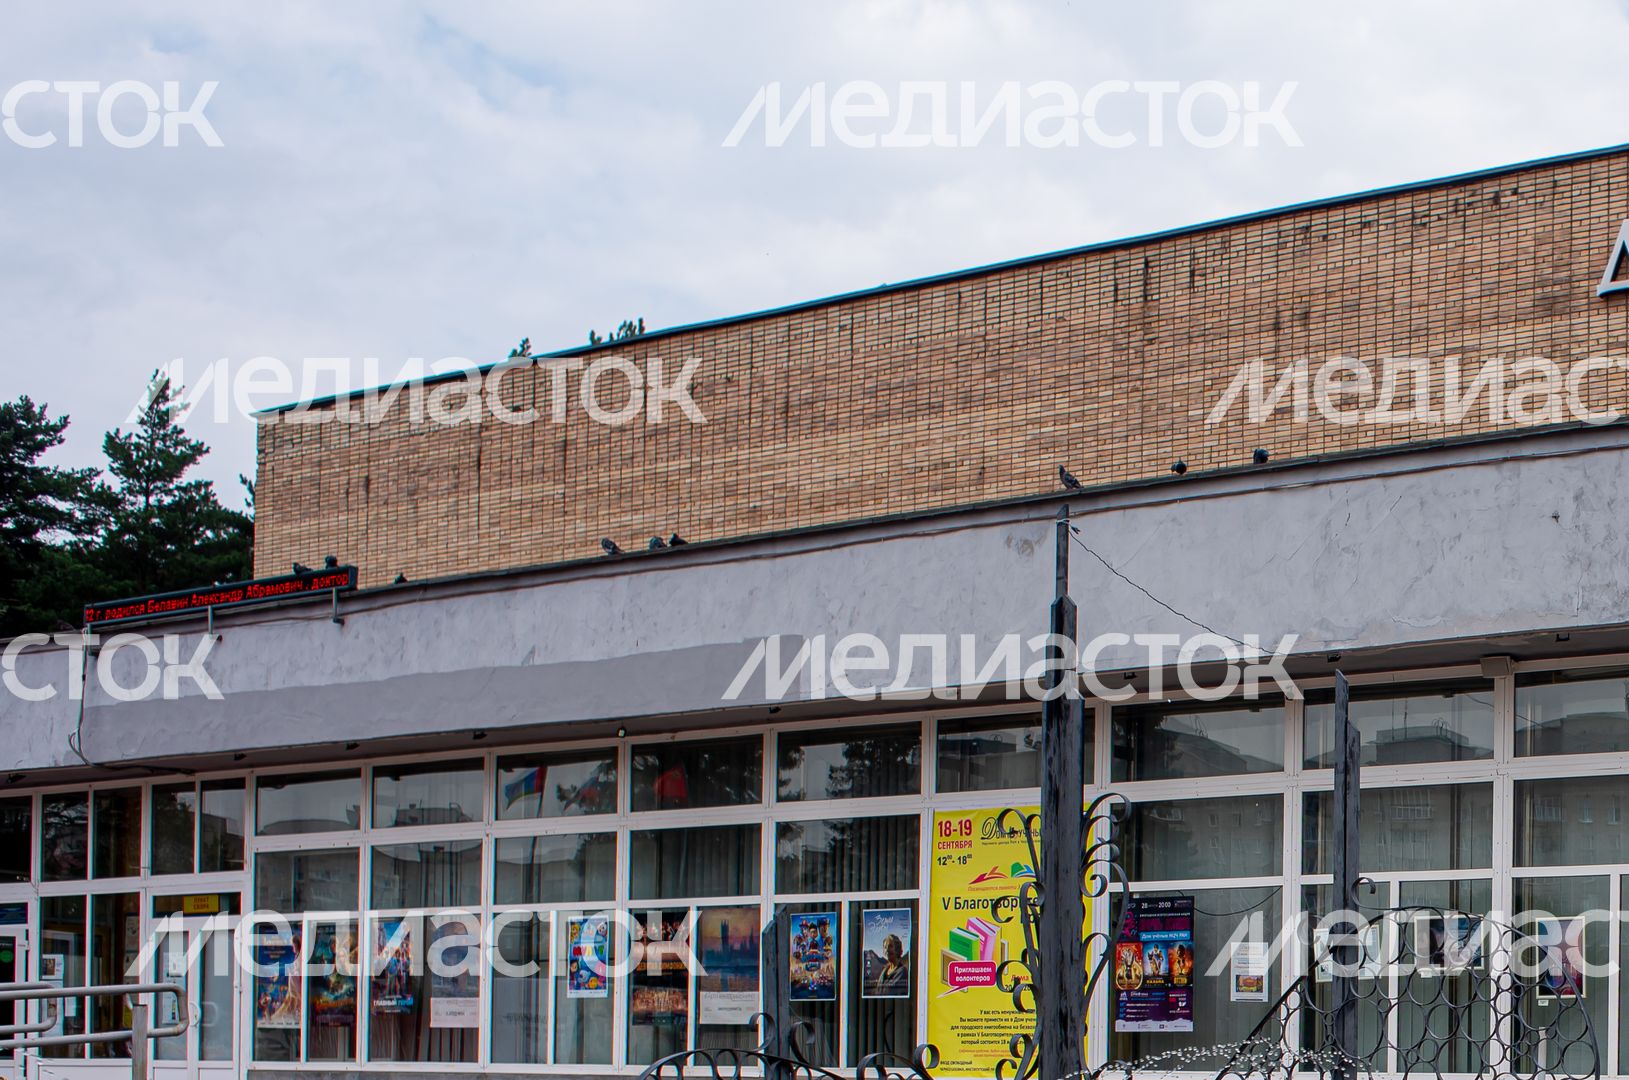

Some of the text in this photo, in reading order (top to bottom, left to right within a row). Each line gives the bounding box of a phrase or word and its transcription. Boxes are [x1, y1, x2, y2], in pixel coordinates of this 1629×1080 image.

[105, 604, 145, 620] родился
[147, 598, 189, 613] Белавин
[191, 590, 243, 607] Александр
[246, 581, 303, 599] Абрамович
[312, 574, 349, 591] доктор
[938, 818, 973, 838] 18-19
[938, 840, 973, 850] СЕНТЯБРЯ
[942, 897, 951, 911] V
[954, 966, 992, 974] Приглашаем
